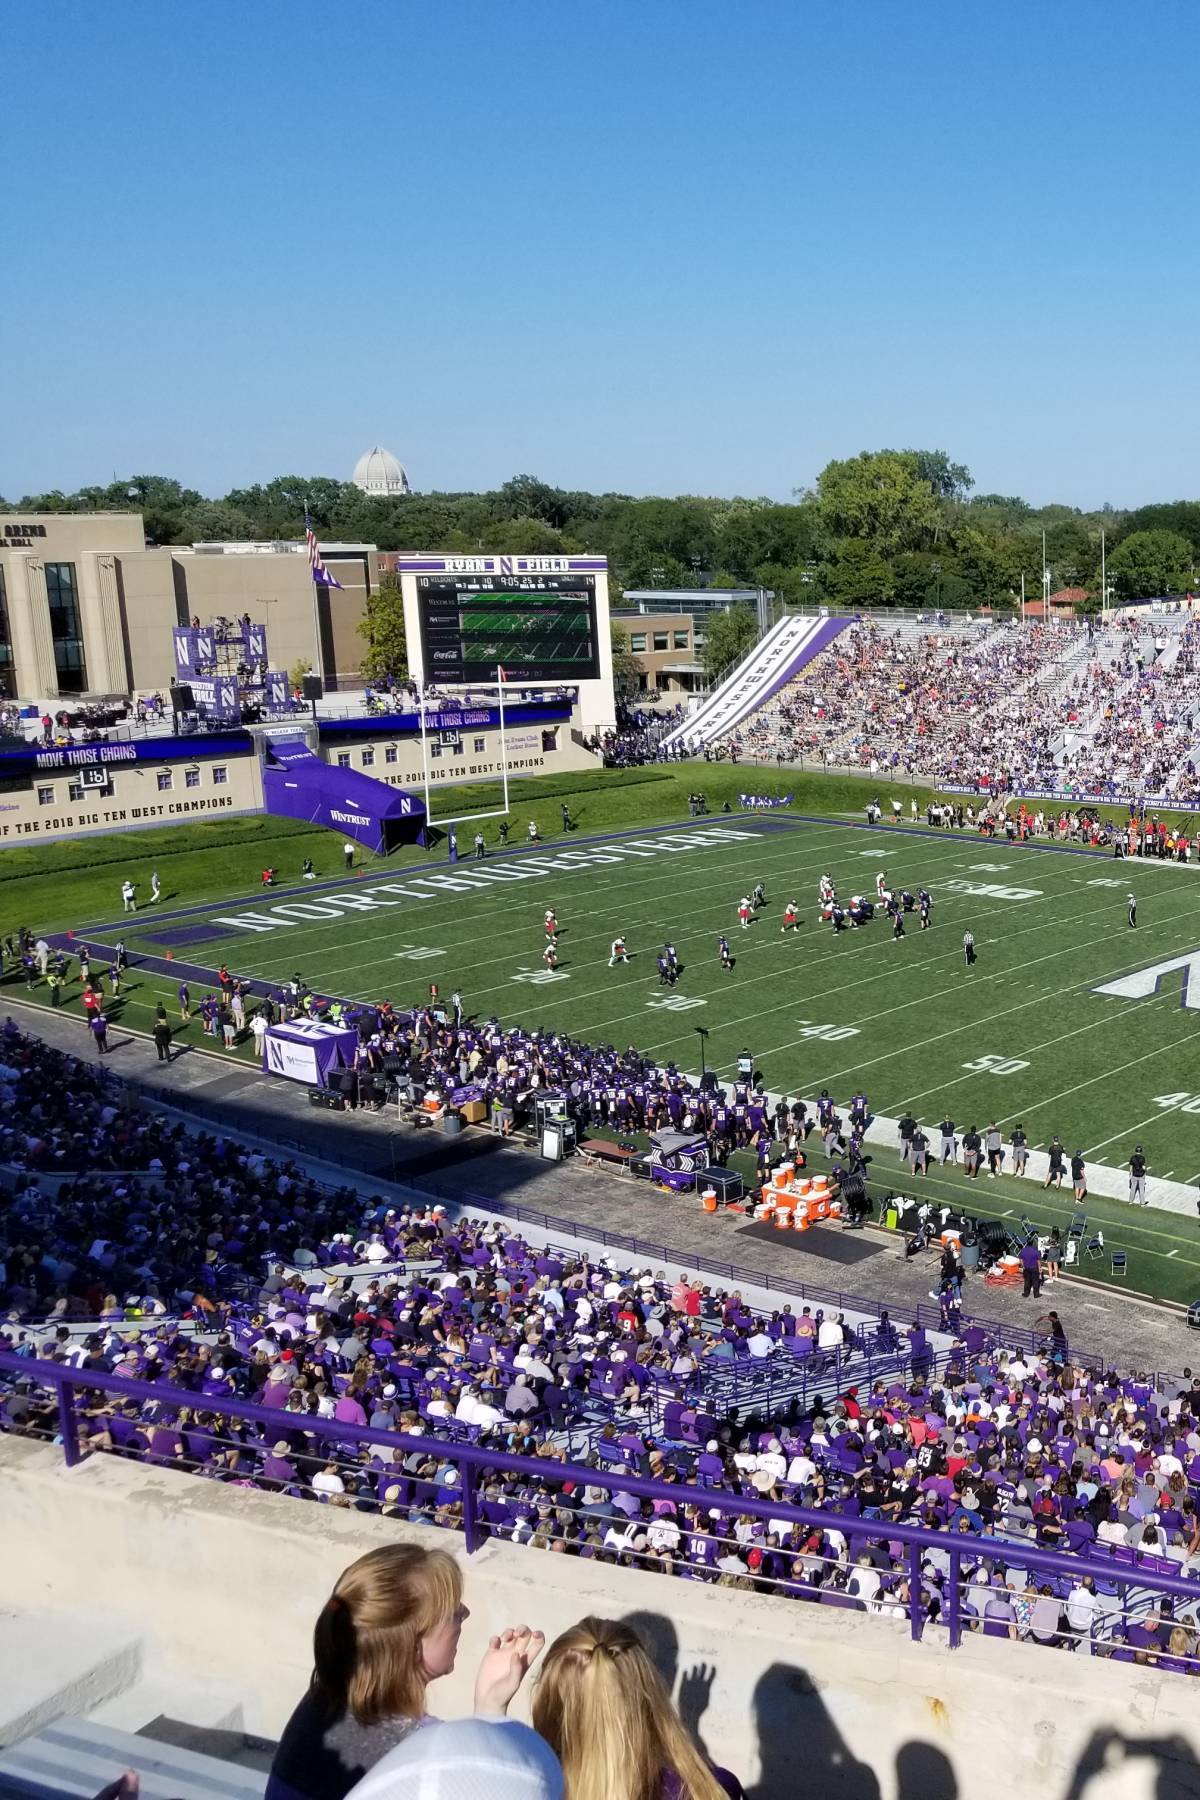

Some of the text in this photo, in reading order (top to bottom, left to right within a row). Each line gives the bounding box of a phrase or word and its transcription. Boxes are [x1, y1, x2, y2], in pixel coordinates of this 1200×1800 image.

[4, 525, 47, 537] ARENA
[445, 556, 569, 575] RYAN N FIELD
[420, 577, 429, 587] 10
[500, 577, 519, 587] 9:05
[586, 577, 594, 585] 14
[176, 637, 189, 666] N
[197, 638, 212, 658] N
[249, 635, 263, 656] N
[221, 685, 235, 707] N
[271, 683, 286, 703] N
[440, 709, 490, 727] THOSE CHAINS
[36, 745, 136, 768] MOVE THOSE CHAINS
[430, 769, 446, 780] BIG
[449, 766, 466, 777] TEN
[470, 764, 494, 774] WEST
[400, 798, 411, 814] N
[15, 796, 233, 834] THE 2018 BIG TEN WEST CHAMPIONS
[330, 809, 371, 826] WINTRUST
[213, 828, 764, 932] NORTHWESTERN
[646, 994, 708, 1011] 30
[800, 1024, 861, 1041] 40
[271, 1040, 285, 1071] N
[961, 1054, 1031, 1075] 50
[766, 1193, 777, 1208] G
[817, 1202, 825, 1212] G
[622, 1320, 631, 1332] 9
[605, 1370, 613, 1384] 2
[690, 1539, 707, 1554] 10
